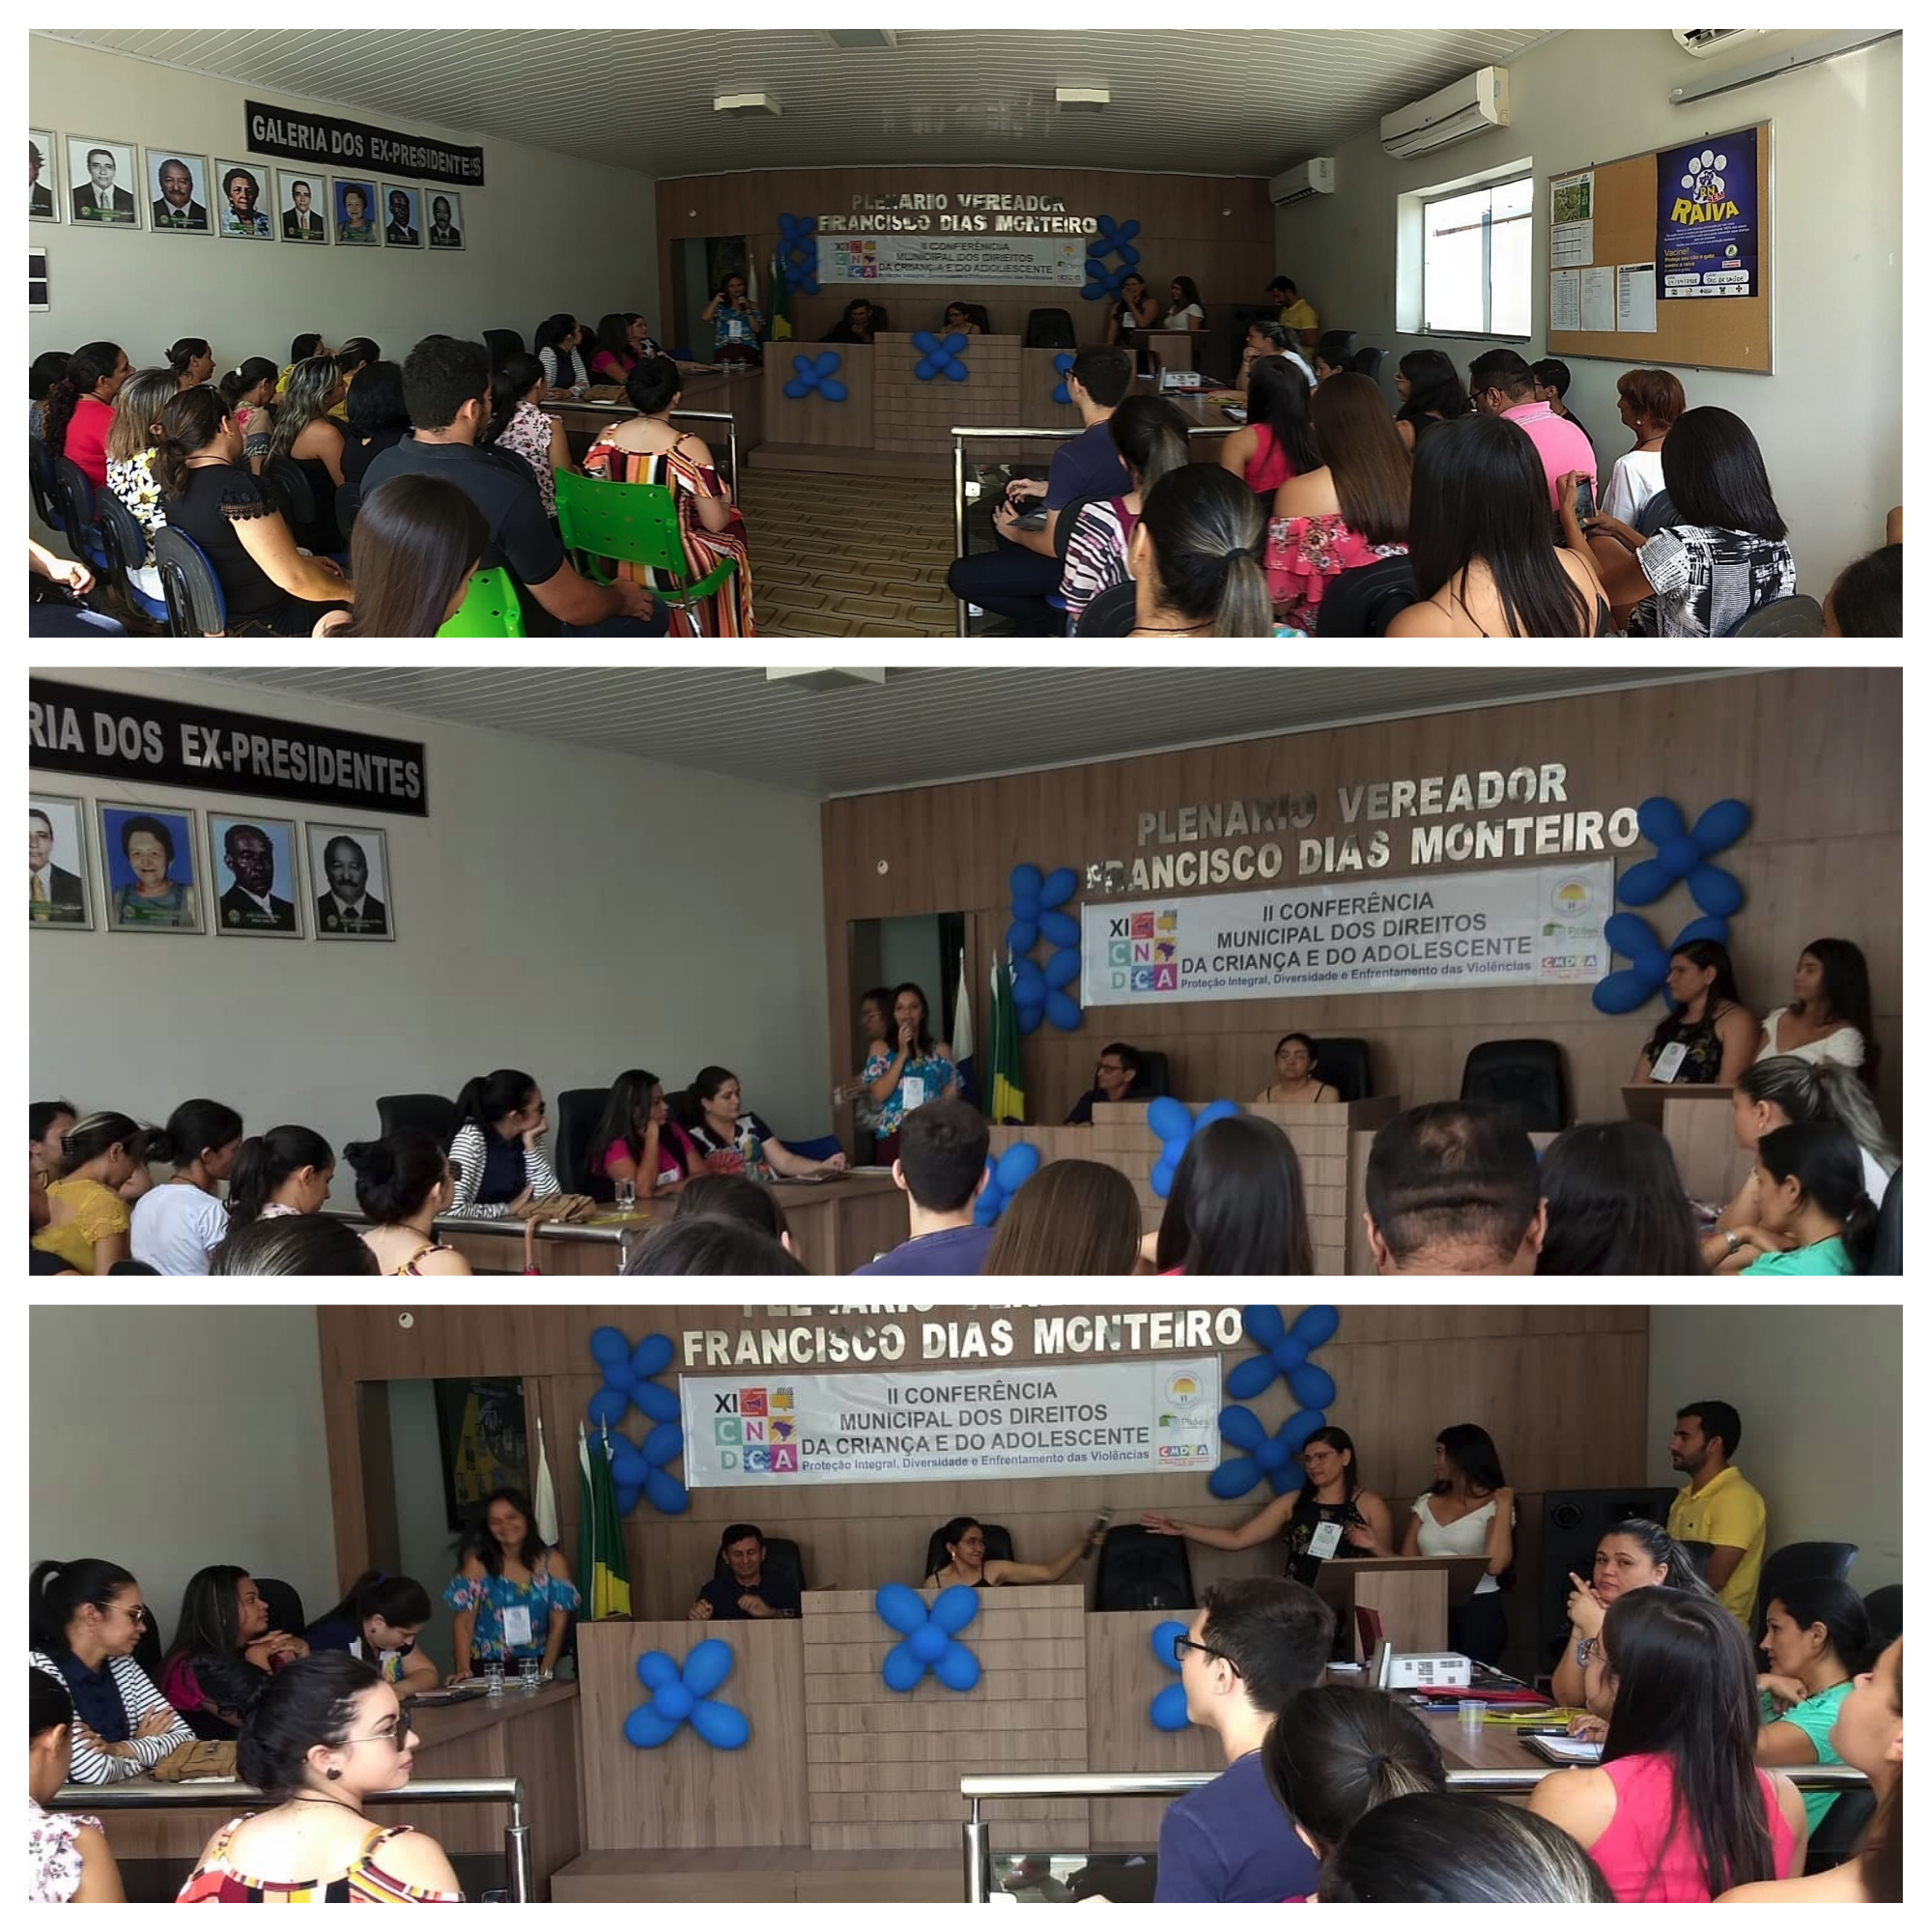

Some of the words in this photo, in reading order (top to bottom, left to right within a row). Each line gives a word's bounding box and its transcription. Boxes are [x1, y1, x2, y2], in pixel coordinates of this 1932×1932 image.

[252, 114, 328, 152] GALERIA
[330, 129, 364, 157] DOS
[851, 193, 949, 211] PLEARIO
[1699, 185, 1717, 198] RN
[1707, 190, 1725, 204] SEM
[817, 214, 931, 231] FRANCISCO
[940, 214, 988, 232] DIAS
[994, 214, 1098, 234] MONTEIRO
[1670, 197, 1740, 226] RAIVA
[878, 263, 893, 271] DA
[956, 253, 980, 263] DOS
[94, 711, 164, 764] DOS
[180, 723, 421, 800] EX-PRESIDENTES
[1136, 790, 1318, 847] PLENARIO
[1337, 762, 1568, 824] VEREADOR
[1298, 829, 1391, 875] DIAS
[1410, 807, 1640, 867] MONTEIRO
[1263, 905, 1274, 923] II
[1279, 891, 1435, 921] CONFERÊNCIA
[1109, 918, 1129, 937] XI
[1217, 924, 1324, 950] MUNICIPAL
[1330, 920, 1377, 942] DOS
[1382, 913, 1488, 938] DIREITOS
[1181, 956, 1208, 975] DA
[1212, 951, 1301, 974] CRIANÇA
[1306, 949, 1320, 967] E
[1325, 946, 1357, 966] DO
[1361, 936, 1533, 965] ADOLESCENTE
[1180, 976, 1227, 990] Proteção
[1273, 970, 1339, 985] Diversidade
[1341, 971, 1349, 980] e
[1351, 965, 1438, 980] Enfrentamento
[1441, 963, 1463, 976] das
[1466, 959, 1532, 974] Violências
[682, 1323, 906, 1367] FRANCISCO
[922, 1317, 1014, 1359] DIAS
[1033, 1306, 1243, 1355] MONTEIRO
[714, 1393, 738, 1413] XI
[887, 1387, 898, 1406] II
[904, 1379, 1059, 1405] CONFERÊNCIA
[839, 1409, 953, 1432] MUNICIPAL
[958, 1407, 1004, 1427] DOS
[1009, 1404, 1109, 1425] DIREITOS
[802, 1437, 832, 1457] DA
[835, 1435, 930, 1458] CRIANÇA
[935, 1435, 950, 1452] E
[954, 1433, 986, 1451] DO
[991, 1426, 1151, 1449] ADOLESCENTE
[802, 1459, 852, 1473] Proteção
[902, 1455, 968, 1469] Diversidade
[971, 1458, 979, 1467] e
[981, 1453, 1065, 1465] Enfrentamento
[1066, 1451, 1089, 1463] das
[1091, 1449, 1151, 1463] Violências
